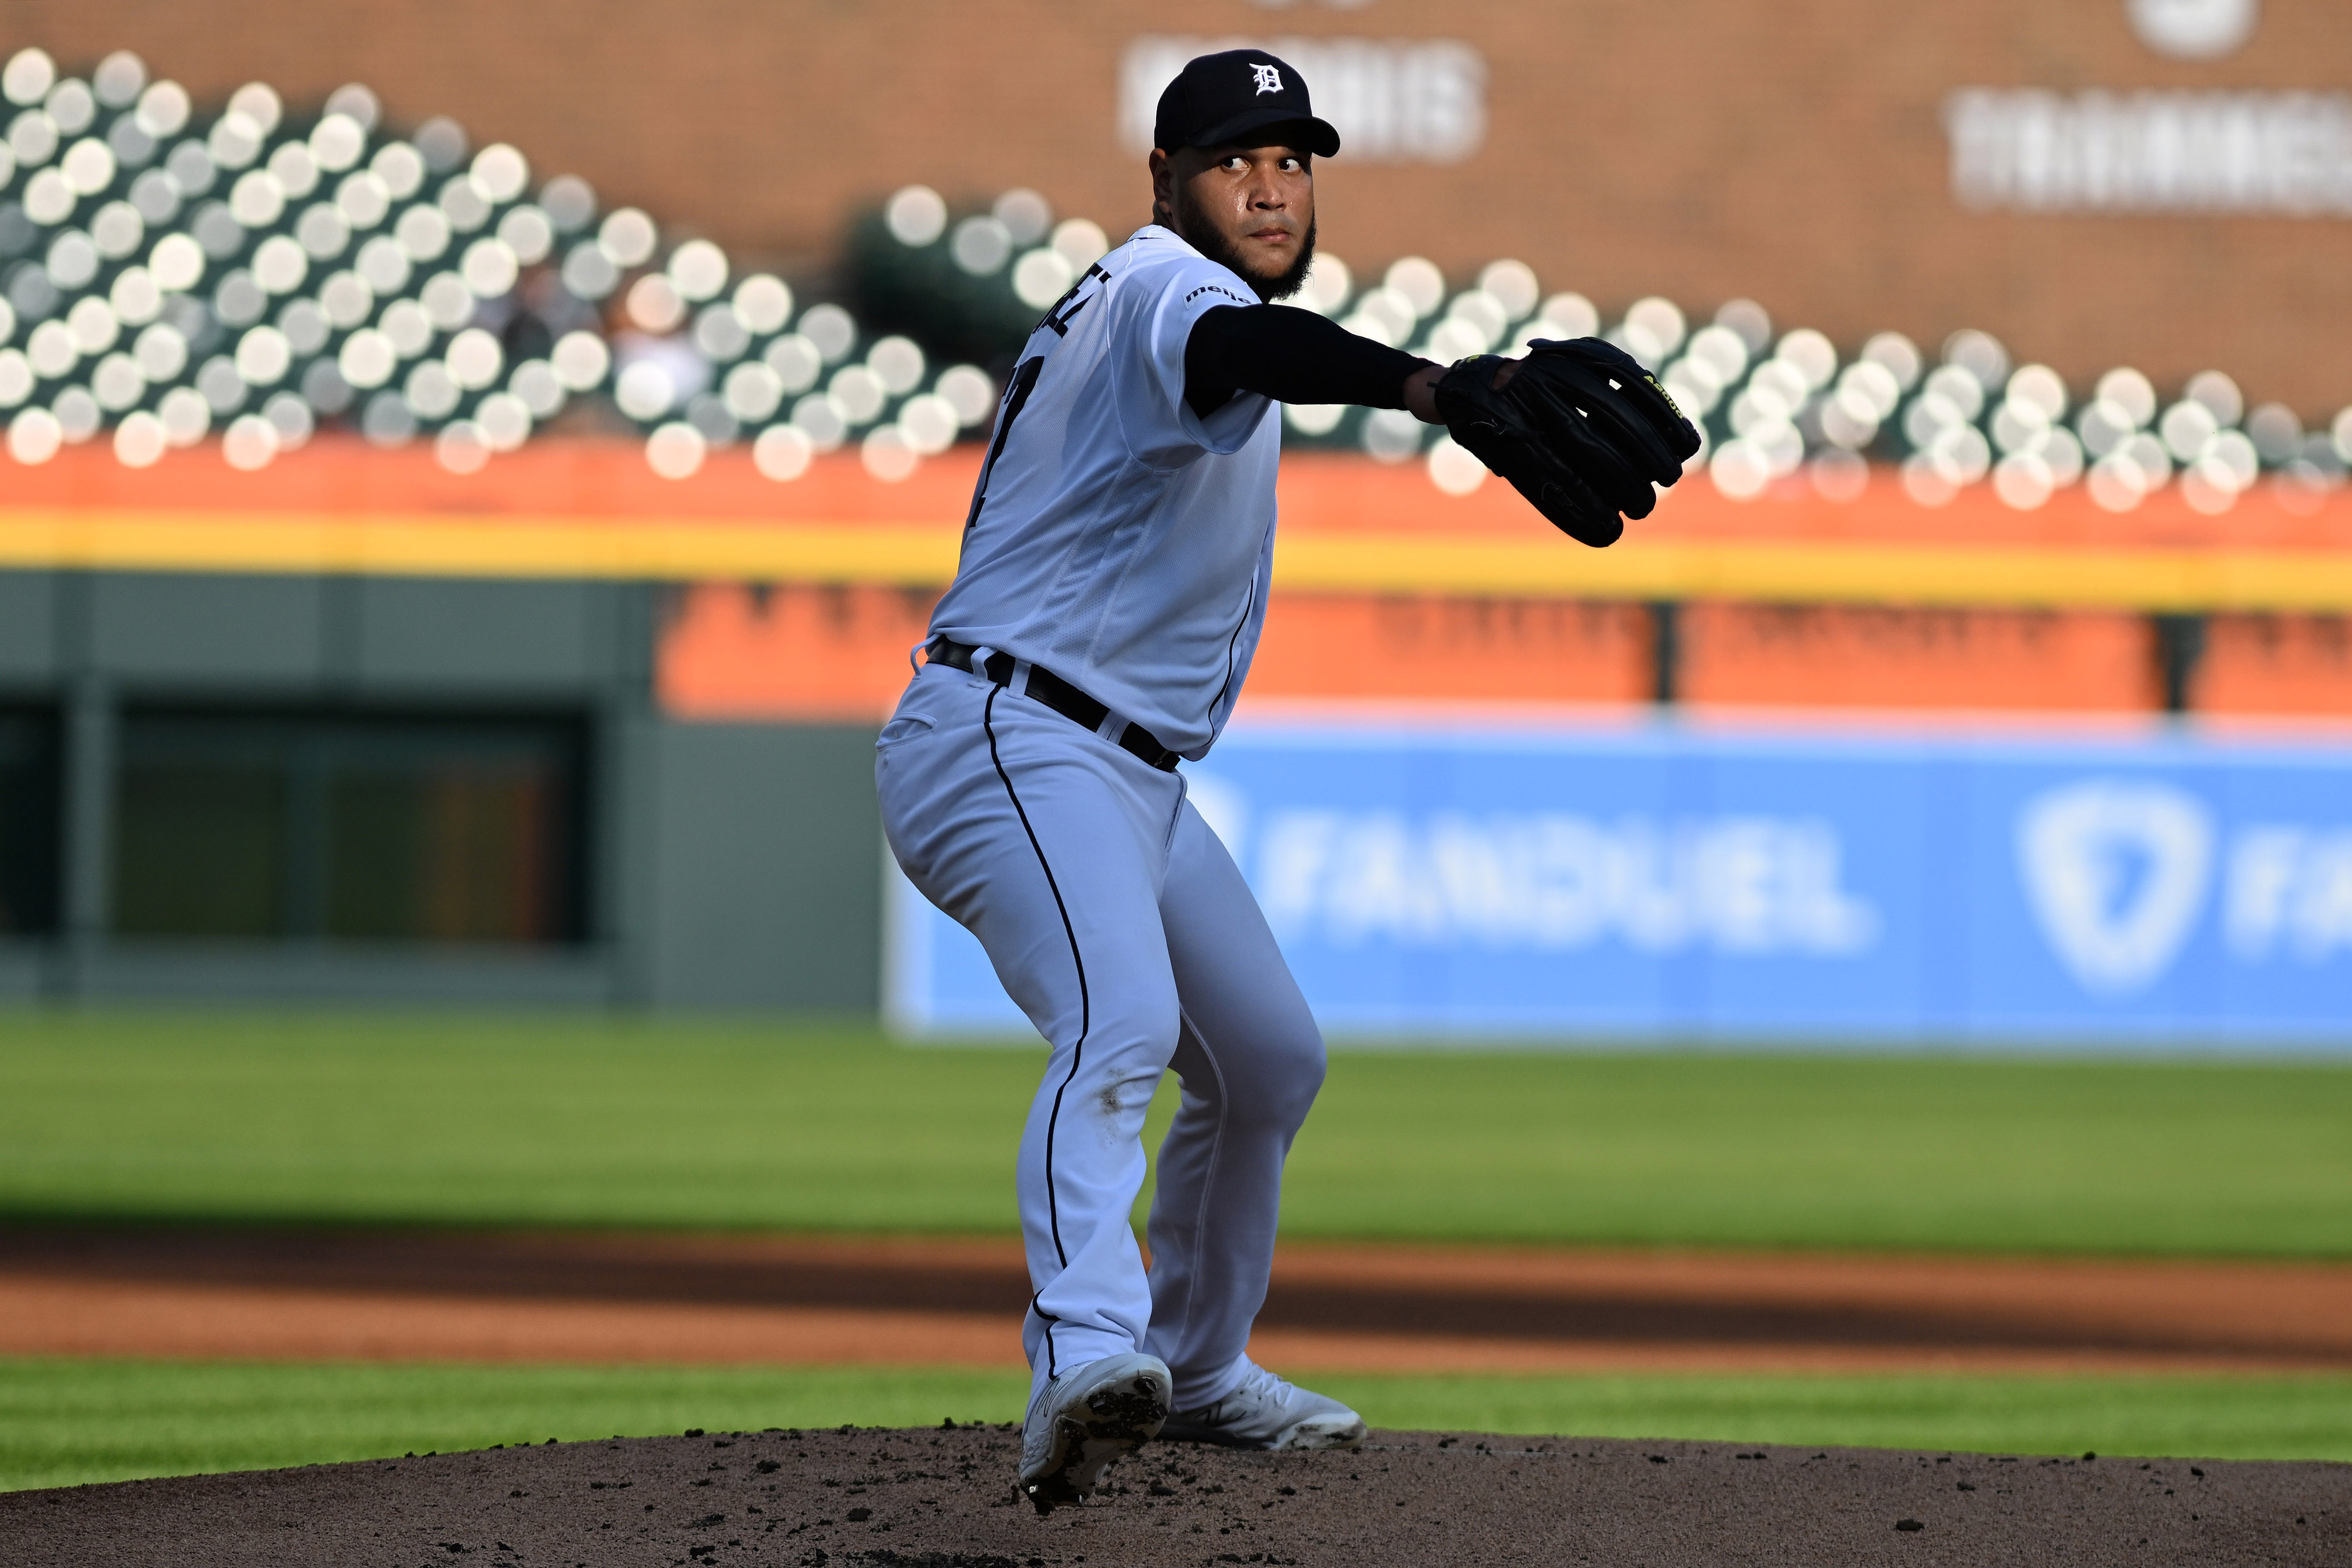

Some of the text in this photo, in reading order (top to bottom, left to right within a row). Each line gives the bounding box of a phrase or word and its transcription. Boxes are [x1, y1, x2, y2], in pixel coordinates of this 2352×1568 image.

[1249, 63, 1284, 96] D
[1186, 286, 1251, 304] meije
[1643, 375, 1683, 419] A2000
